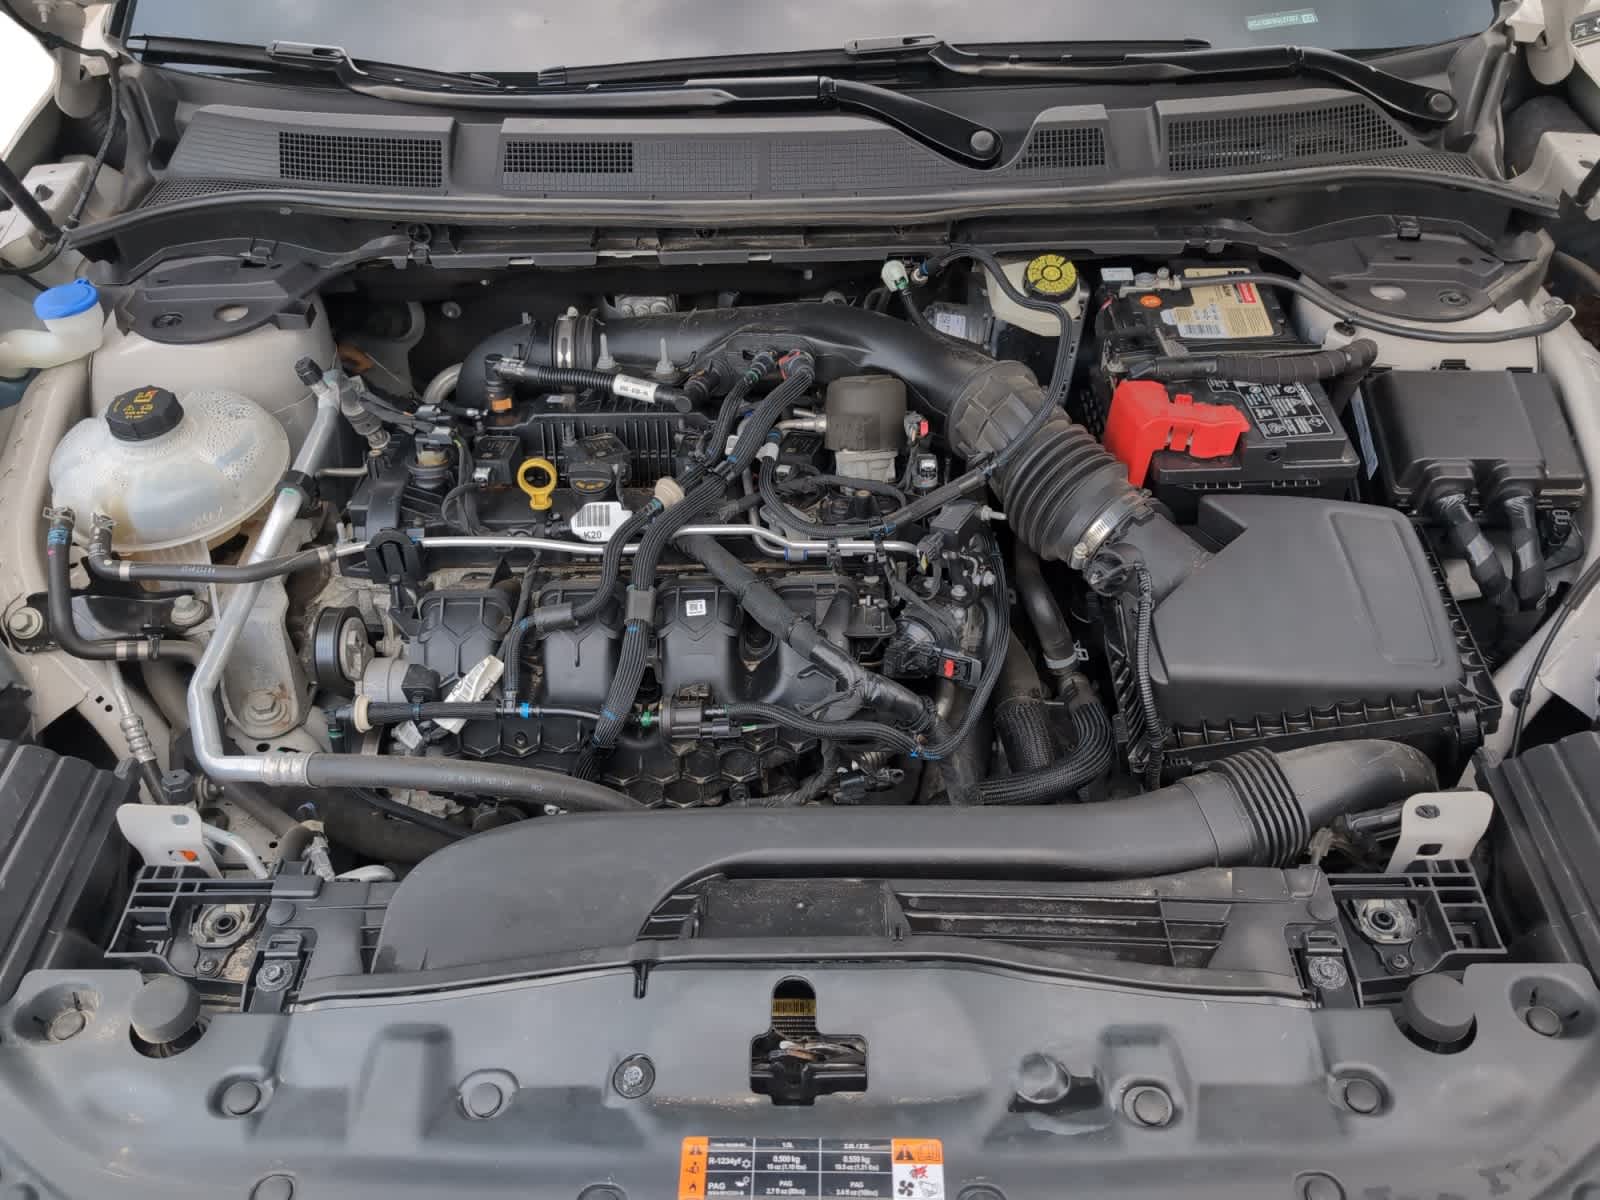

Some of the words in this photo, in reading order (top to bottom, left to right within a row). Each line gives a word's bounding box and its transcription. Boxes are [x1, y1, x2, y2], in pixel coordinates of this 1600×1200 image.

[708, 1157, 741, 1166] R-1234yf
[792, 1155, 801, 1164] kg
[861, 1156, 870, 1164] kg
[708, 1182, 726, 1190] PAG
